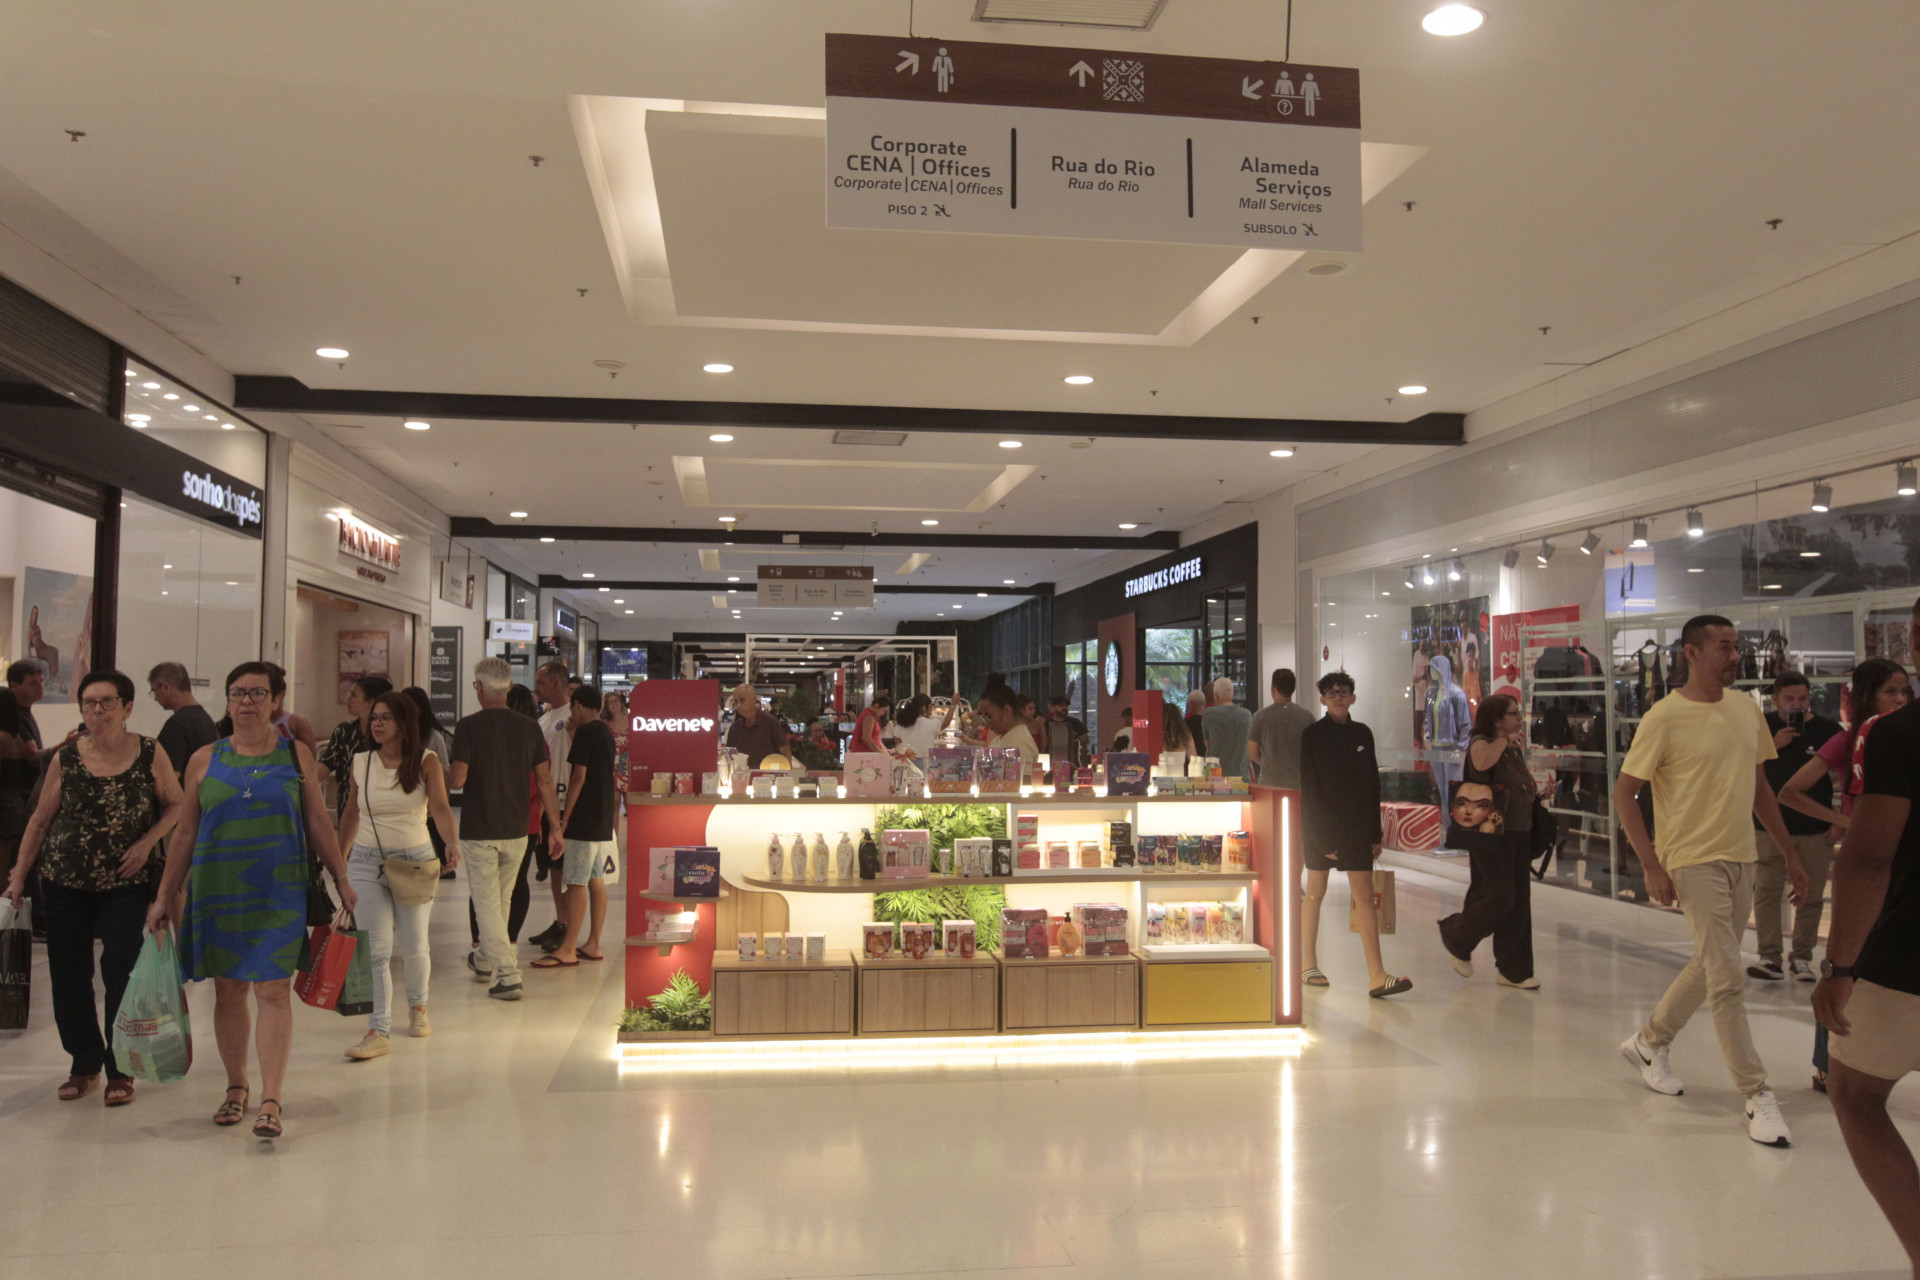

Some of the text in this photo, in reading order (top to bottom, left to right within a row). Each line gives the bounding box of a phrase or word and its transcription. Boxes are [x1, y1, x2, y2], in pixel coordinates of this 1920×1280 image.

[871, 135, 967, 156] Corporate
[846, 154, 991, 178] CENA Offices
[1051, 155, 1156, 177] Rua do Rio
[1240, 157, 1320, 177] Alameda
[834, 175, 1003, 196] Corporate CENA Offices
[1068, 177, 1140, 193] Rua do Rio
[1255, 177, 1332, 199] Serviços
[888, 204, 928, 216] PISO 2
[1238, 197, 1323, 213] Mall Services
[1243, 223, 1297, 236] SUBSOLO
[1125, 556, 1202, 598] STARBUCKS COFFEE
[632, 715, 701, 732] Davene
